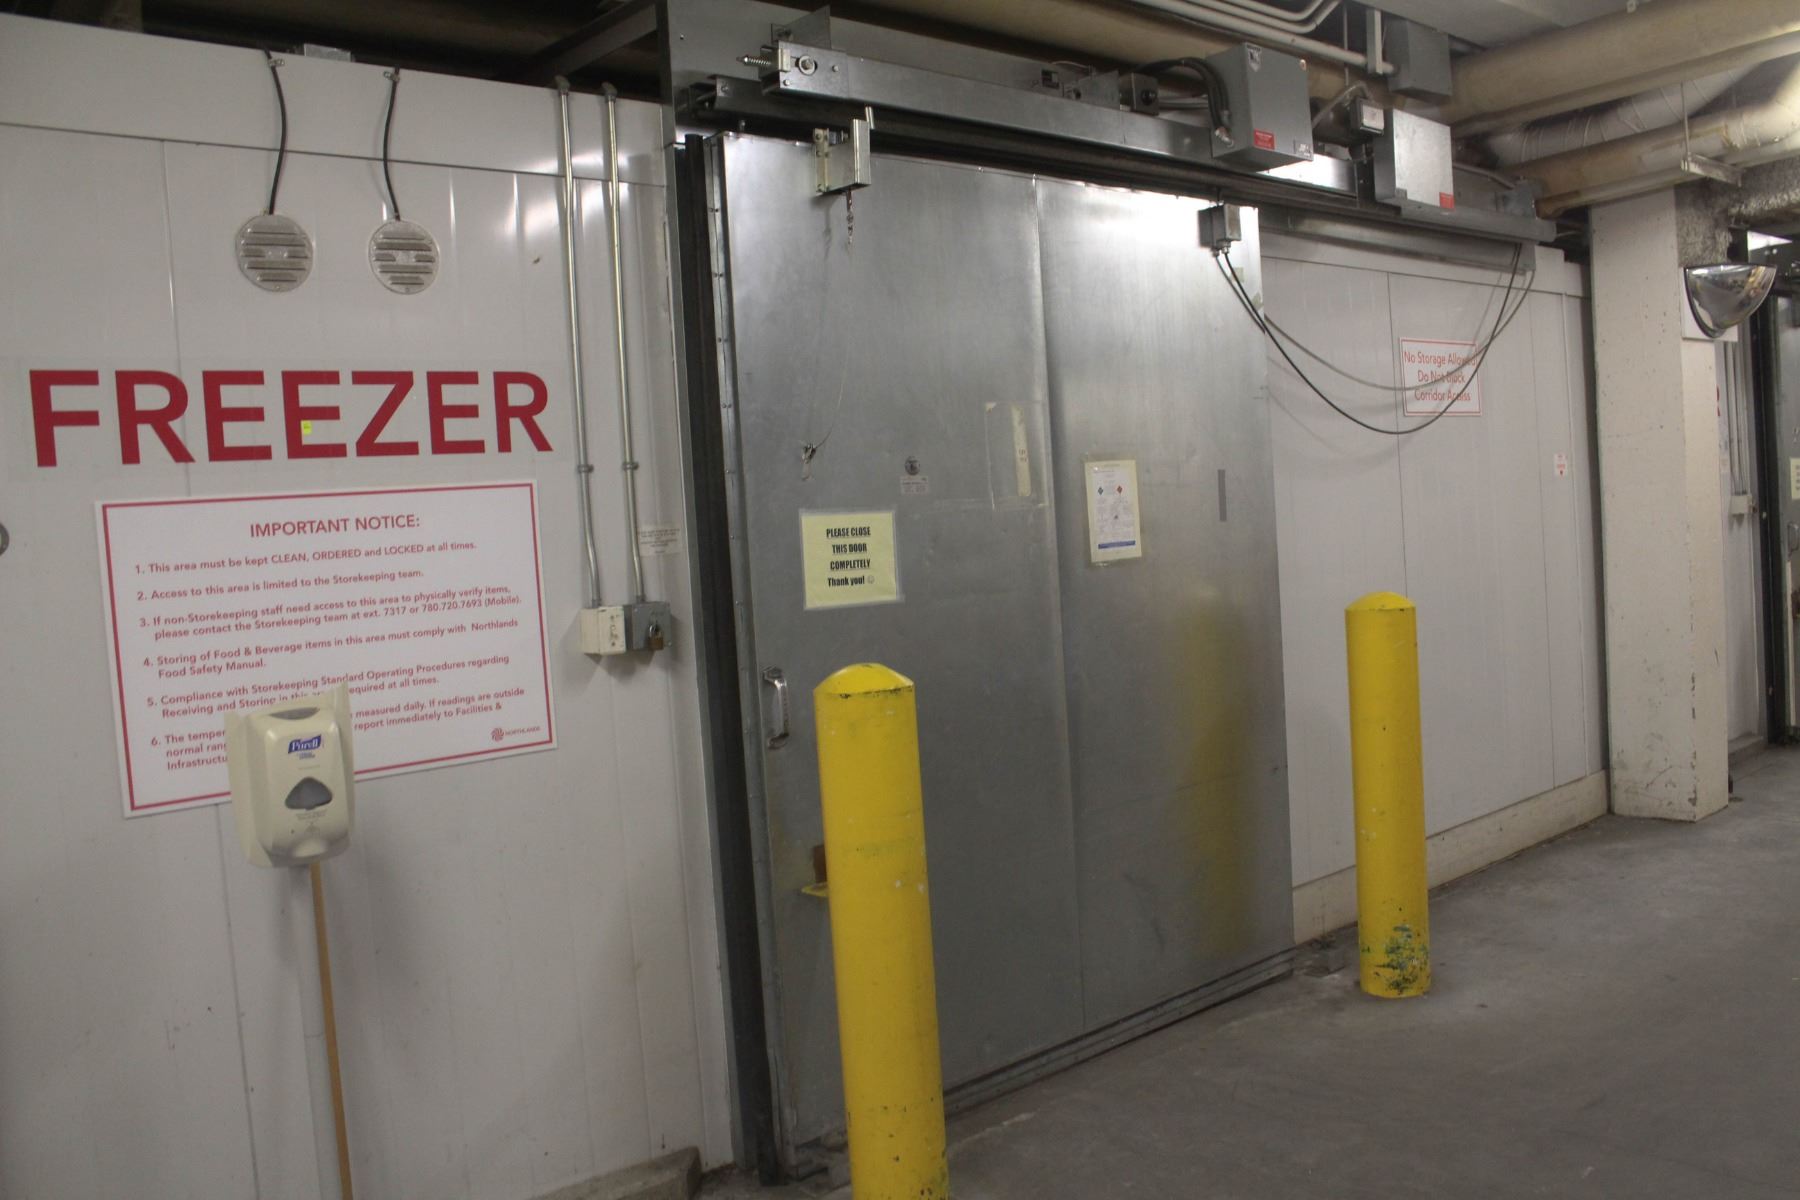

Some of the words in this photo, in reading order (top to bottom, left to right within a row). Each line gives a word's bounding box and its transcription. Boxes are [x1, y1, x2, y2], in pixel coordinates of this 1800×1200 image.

[1404, 352, 1415, 363] No
[1418, 352, 1445, 368] Storage
[1418, 370, 1428, 382] Do
[1415, 388, 1445, 400] Corridor
[29, 370, 554, 467] FREEZER
[251, 518, 349, 537] IMPORTANT
[355, 514, 420, 531] NOTICE:
[826, 528, 849, 538] PLEASE
[851, 526, 871, 537] CLOSE
[136, 565, 145, 575] 1.
[148, 563, 170, 573] This
[174, 563, 196, 571] area
[200, 561, 225, 569] must
[229, 558, 242, 567] be
[245, 556, 268, 567] kept
[312, 549, 361, 560] ORDERED
[364, 547, 382, 557] and
[385, 545, 424, 555] LOCKED
[438, 542, 448, 551] all
[450, 542, 476, 550] times.
[832, 544, 847, 554] THIS
[849, 543, 867, 553] DOOR
[830, 559, 870, 570] COMPLETELY
[137, 591, 147, 601] 2.
[151, 590, 187, 599] Access
[206, 586, 224, 595] this
[227, 585, 249, 593] area
[263, 579, 297, 589] limited
[301, 579, 311, 587] to
[314, 576, 330, 585] the
[333, 571, 395, 584] Storekeeping
[398, 570, 424, 578] team.
[828, 577, 849, 587] Thank
[850, 576, 865, 586] you!
[140, 618, 150, 627] 3.
[153, 616, 161, 625] If
[164, 610, 258, 625] non-Storekeeping
[261, 605, 283, 616] staff
[286, 603, 310, 613] need
[313, 601, 344, 611] access
[360, 597, 376, 606] this
[379, 597, 398, 605] area
[414, 590, 456, 602] physically
[459, 586, 483, 596] verify
[155, 629, 189, 640] please
[193, 625, 231, 635] contact
[235, 622, 251, 631] the
[255, 615, 321, 629] Storekeeping
[324, 613, 348, 622] team
[363, 610, 380, 619] ext.
[384, 607, 406, 616] 7317
[422, 600, 482, 612] 780.720.7693
[485, 596, 521, 607] (Mobile).
[144, 657, 153, 667] 4.
[157, 655, 196, 666] Storing
[200, 651, 210, 661] of
[214, 650, 240, 659] Food
[244, 647, 252, 656] &
[255, 644, 302, 654] Beverage
[305, 640, 331, 649] items
[334, 638, 343, 646] in
[346, 635, 363, 644] this
[366, 634, 385, 642] area
[388, 631, 410, 640] must
[413, 626, 445, 638] comply
[447, 624, 466, 634] with
[471, 619, 518, 631] Northlands
[148, 698, 157, 706] 5.
[161, 691, 223, 705] Compliance
[226, 687, 248, 698] with
[252, 678, 318, 693] Storekeeping
[321, 672, 364, 685] Standard
[367, 667, 414, 679] Operating
[416, 661, 465, 673] Procedures
[468, 655, 510, 668] regarding
[158, 668, 186, 679] Food
[190, 665, 222, 676] Safety
[226, 659, 266, 671] Manual.
[162, 705, 214, 718] Receiving
[217, 702, 236, 712] and
[349, 682, 385, 693] equired
[388, 681, 397, 689] at
[400, 679, 410, 687] all
[413, 676, 439, 686] times.
[151, 736, 161, 746] 6.
[165, 734, 184, 744] The
[355, 705, 400, 718] measured
[404, 701, 425, 712] daily.
[429, 699, 435, 707] If
[438, 694, 475, 706] readings
[494, 688, 525, 698] outside
[166, 746, 203, 757] normal
[206, 743, 227, 751] ran
[354, 720, 384, 731] report
[386, 711, 441, 726] immediately
[444, 710, 453, 718] to
[456, 705, 493, 716] Facilities
[495, 702, 502, 710] &
[292, 738, 318, 750] Purell
[167, 756, 228, 770] Infrastructu
